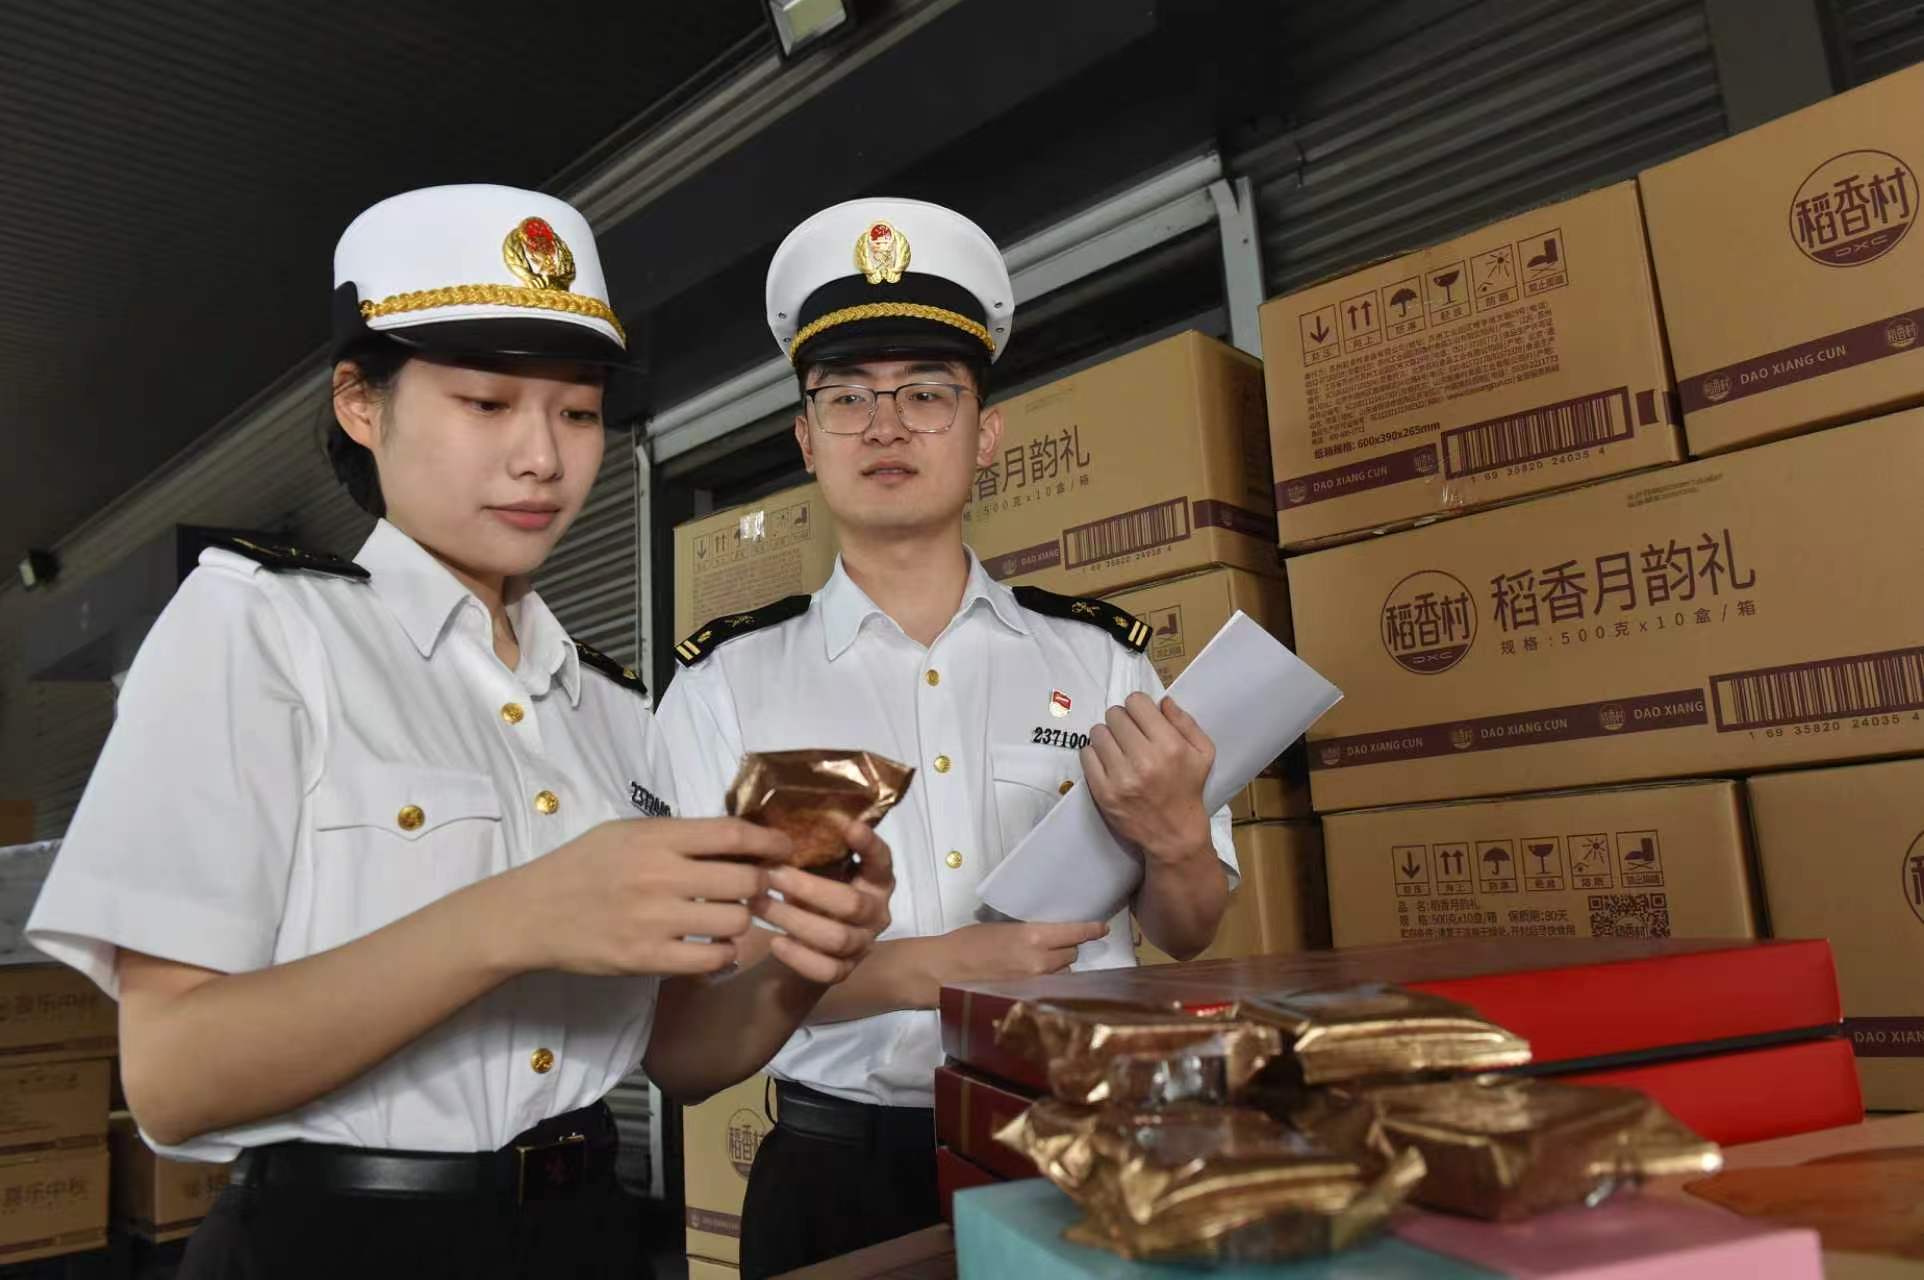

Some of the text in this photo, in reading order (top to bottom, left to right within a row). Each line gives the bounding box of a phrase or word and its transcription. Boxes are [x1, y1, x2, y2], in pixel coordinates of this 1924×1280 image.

[1796, 167, 1910, 249] 稻香村
[1834, 234, 1890, 257] DXC
[1740, 345, 1846, 385] DAO XIANG CUN
[967, 424, 1090, 504] 香月韵礼
[1313, 480, 1334, 493] DAO
[1336, 471, 1366, 487] XIANG
[1367, 465, 1388, 479] CUN
[1489, 528, 1757, 632] 稻香月韵礼
[1386, 592, 1471, 651] 稻香村
[1633, 706, 1661, 720] DAO
[1664, 700, 1704, 717] XIANG
[1480, 718, 1569, 739] DAO XIANG CUN
[1766, 728, 1783, 739] 69
[1794, 721, 1840, 736] 35820
[1852, 714, 1900, 729] 24035
[1911, 711, 1920, 721] 4
[1346, 743, 1368, 758] DAO
[1370, 740, 1401, 755] XIANG
[1402, 736, 1424, 750] CUN
[1855, 1031, 1886, 1043] DAO
